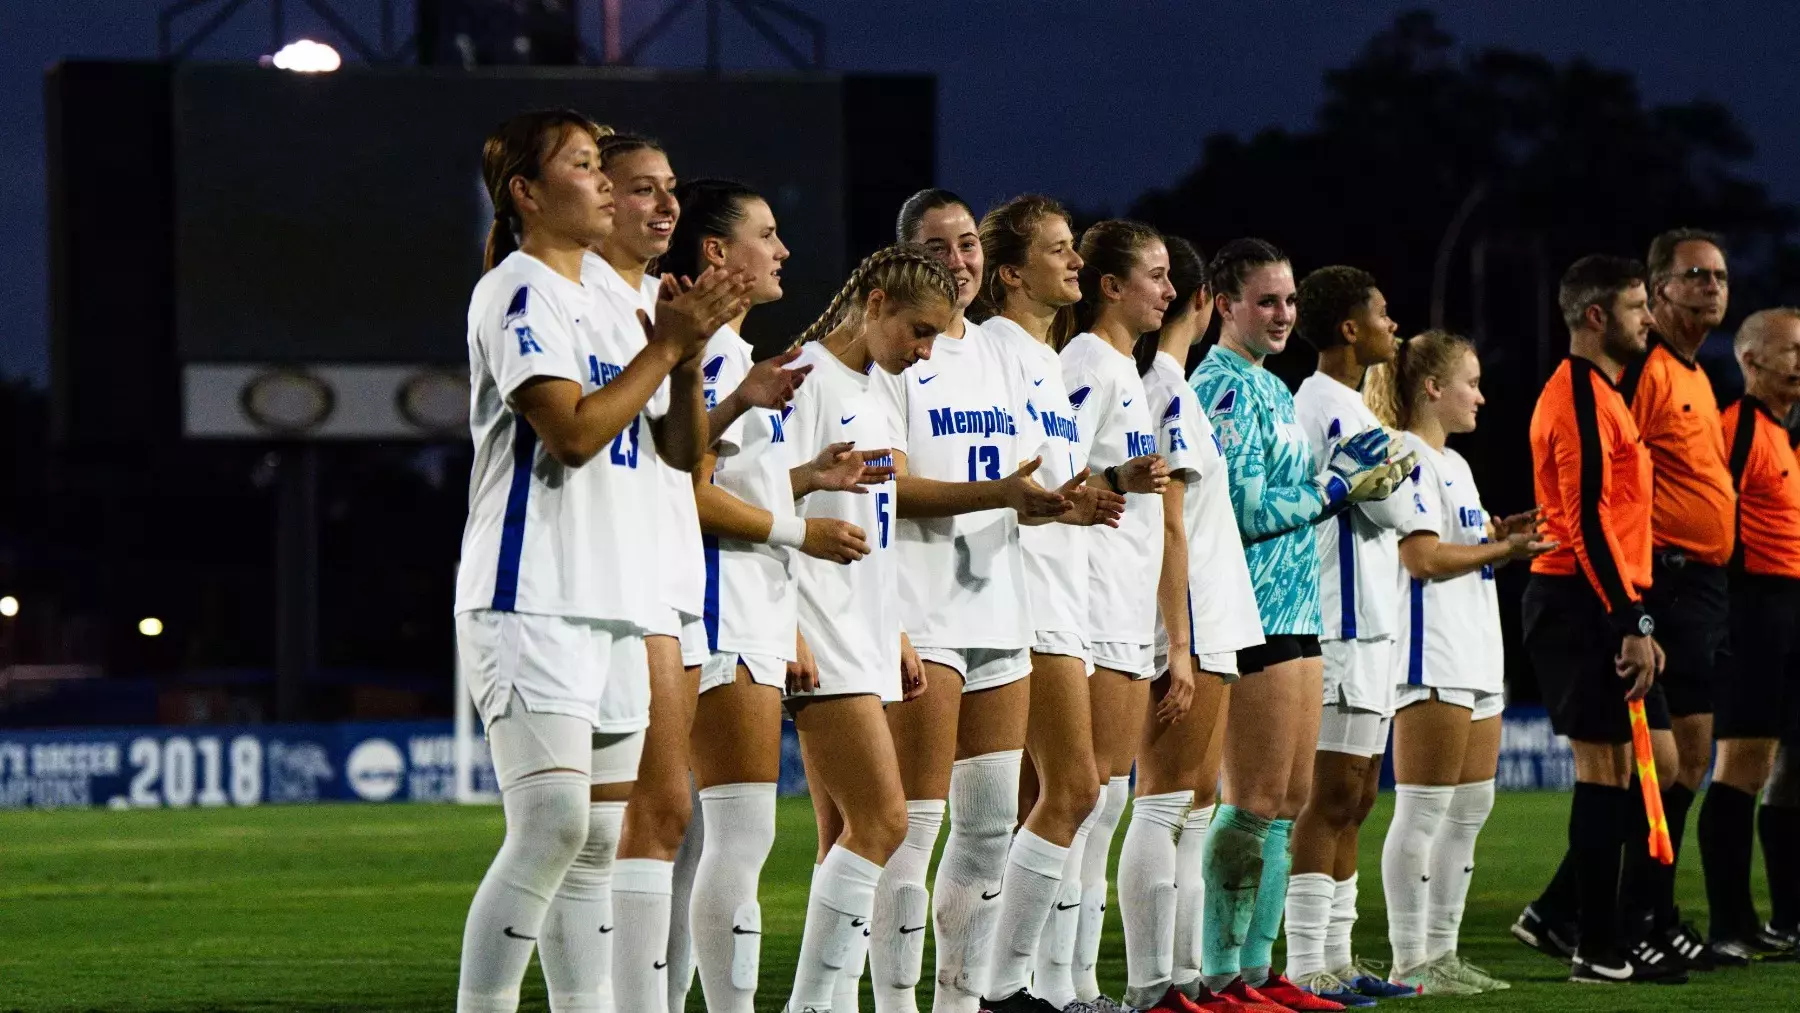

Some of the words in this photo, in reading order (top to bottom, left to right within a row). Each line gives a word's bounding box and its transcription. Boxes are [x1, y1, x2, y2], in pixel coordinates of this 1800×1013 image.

[928, 406, 1017, 438] Memphis
[968, 445, 1001, 482] 13
[875, 493, 889, 548] 5
[129, 736, 261, 807] 2018
